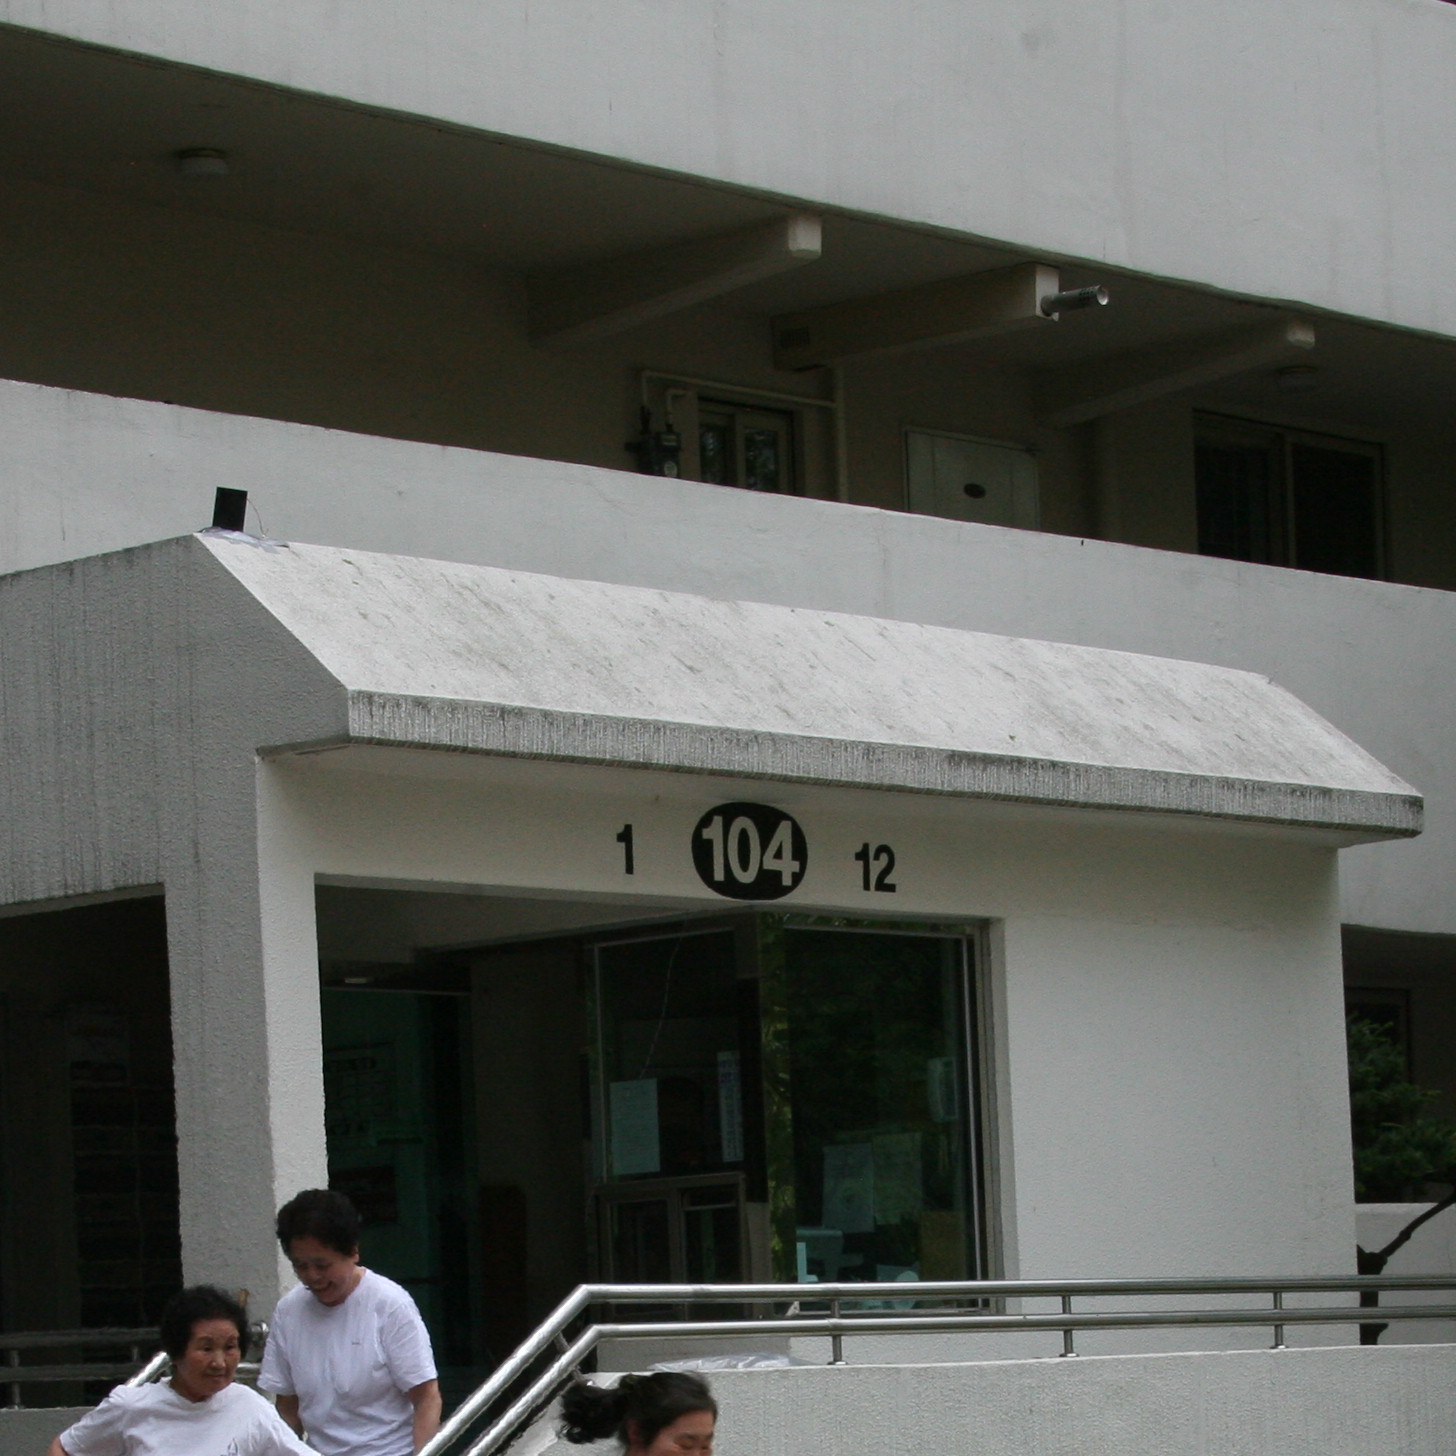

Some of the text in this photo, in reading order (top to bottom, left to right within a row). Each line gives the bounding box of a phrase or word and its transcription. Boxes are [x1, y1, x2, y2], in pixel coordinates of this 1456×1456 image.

[615, 815, 897, 893] 1 104 12
